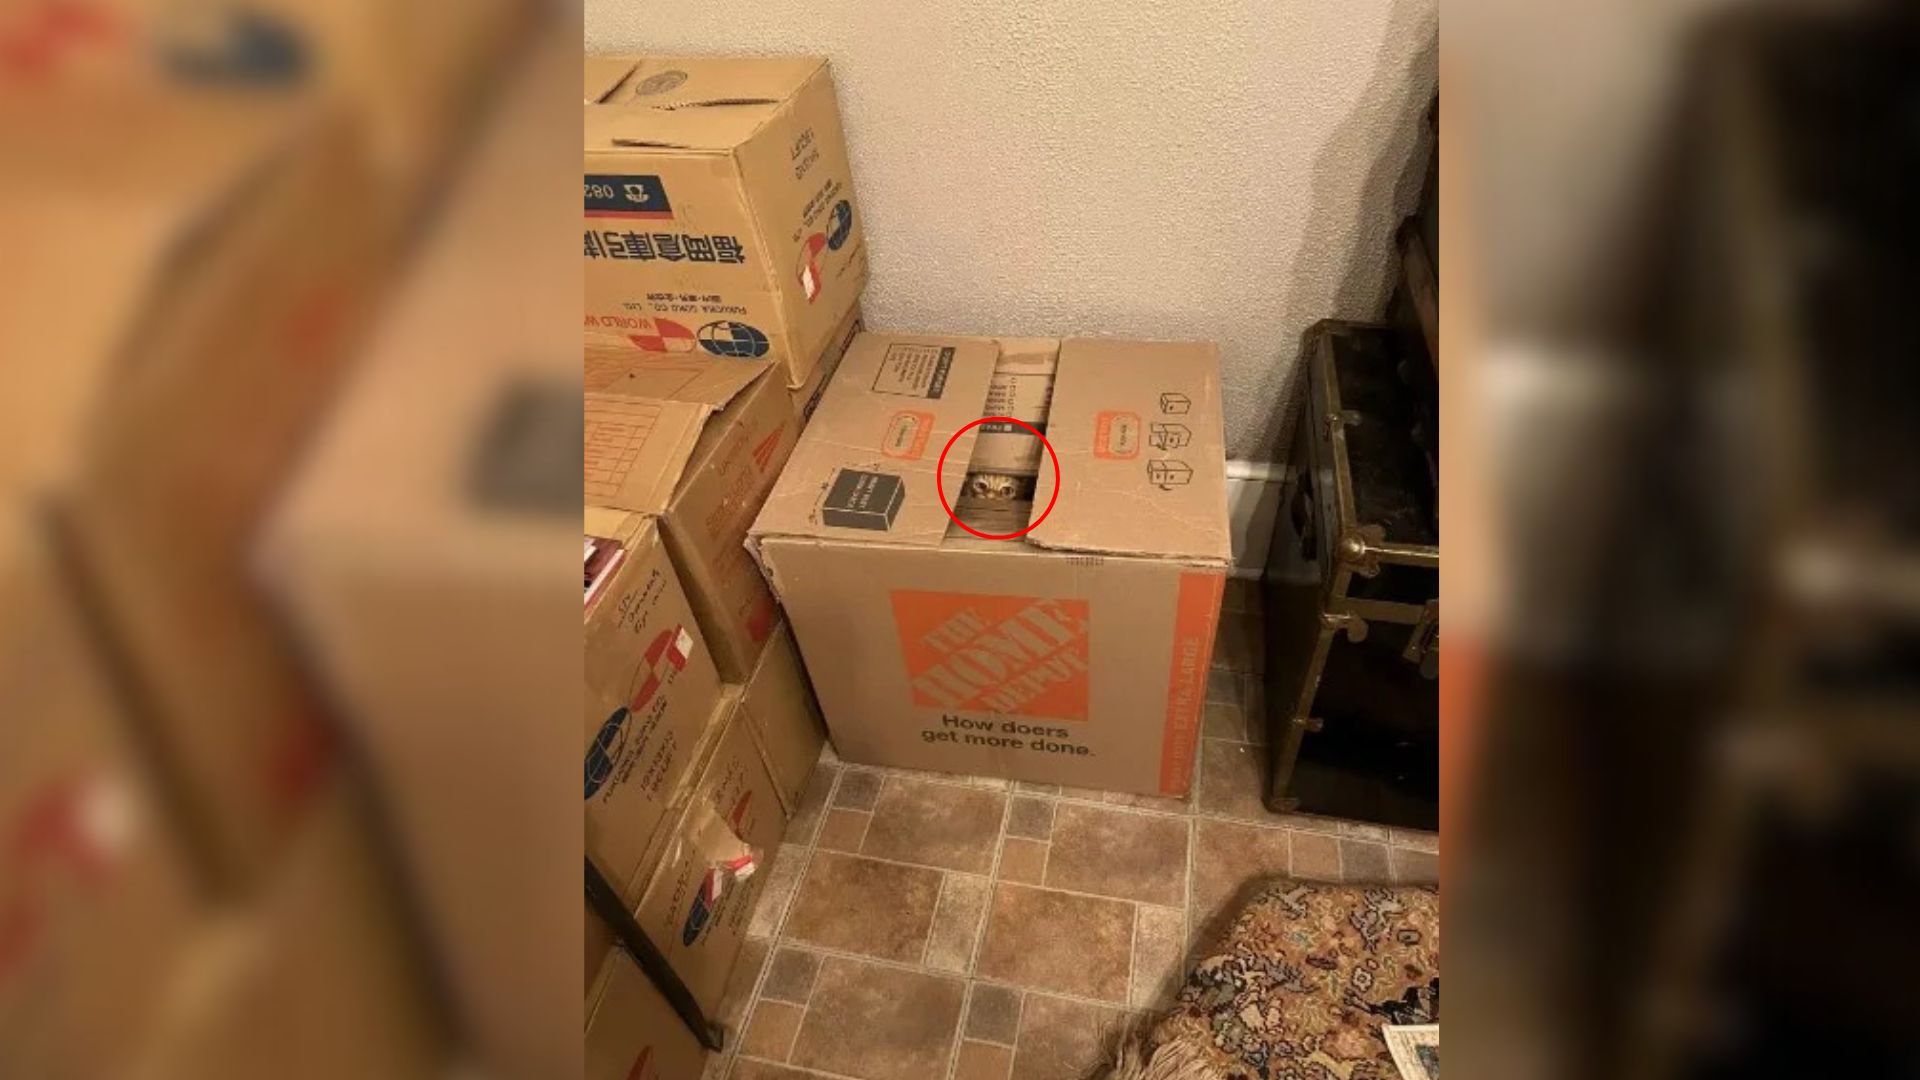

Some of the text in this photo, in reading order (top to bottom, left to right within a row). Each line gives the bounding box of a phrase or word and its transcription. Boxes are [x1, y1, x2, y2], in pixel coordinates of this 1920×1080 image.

[601, 316, 652, 330] WORLD
[911, 598, 1089, 705] HOME
[917, 608, 992, 653] THE
[1183, 636, 1201, 678] LARGE
[979, 645, 1089, 713] DEPOT
[921, 728, 1097, 757] get more done.
[941, 714, 1069, 738] How doers
